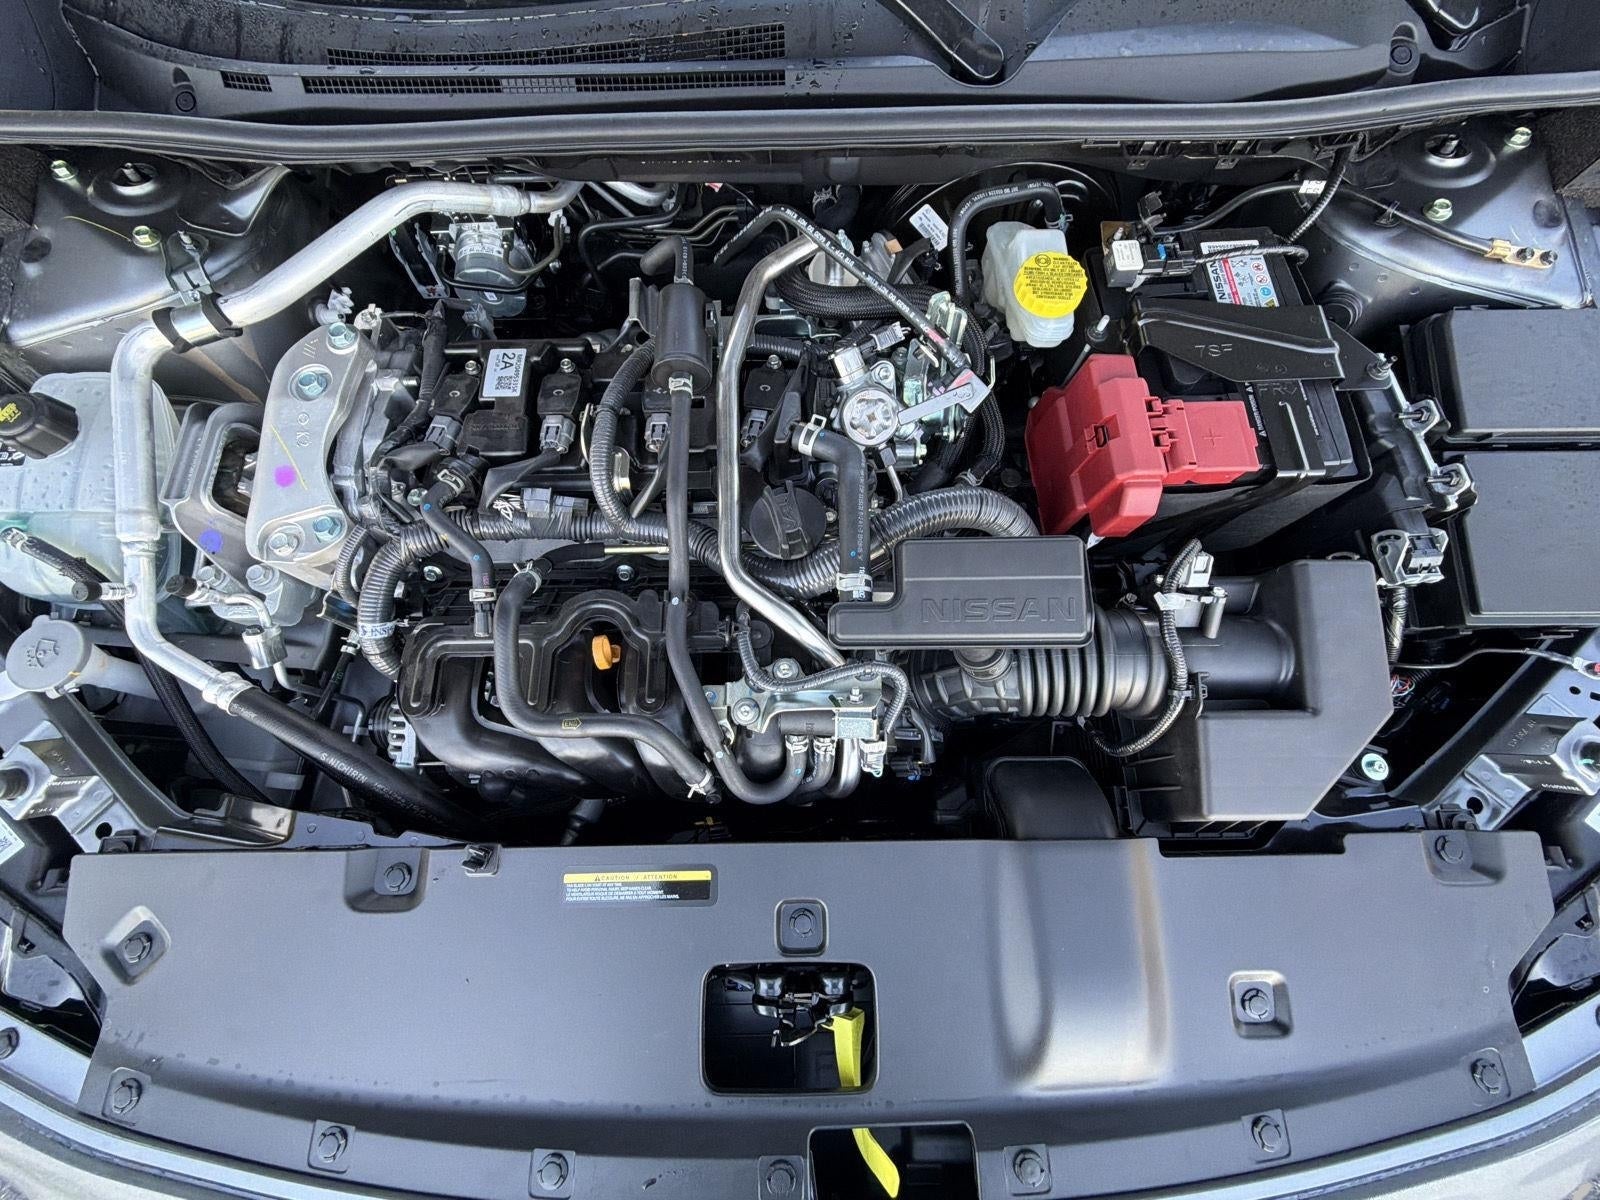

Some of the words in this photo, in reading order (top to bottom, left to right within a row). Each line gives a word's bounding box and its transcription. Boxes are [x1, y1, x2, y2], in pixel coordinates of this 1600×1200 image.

[1210, 260, 1227, 299] NISSAN
[500, 352, 516, 371] 2A
[921, 598, 1076, 622] NISSAN
